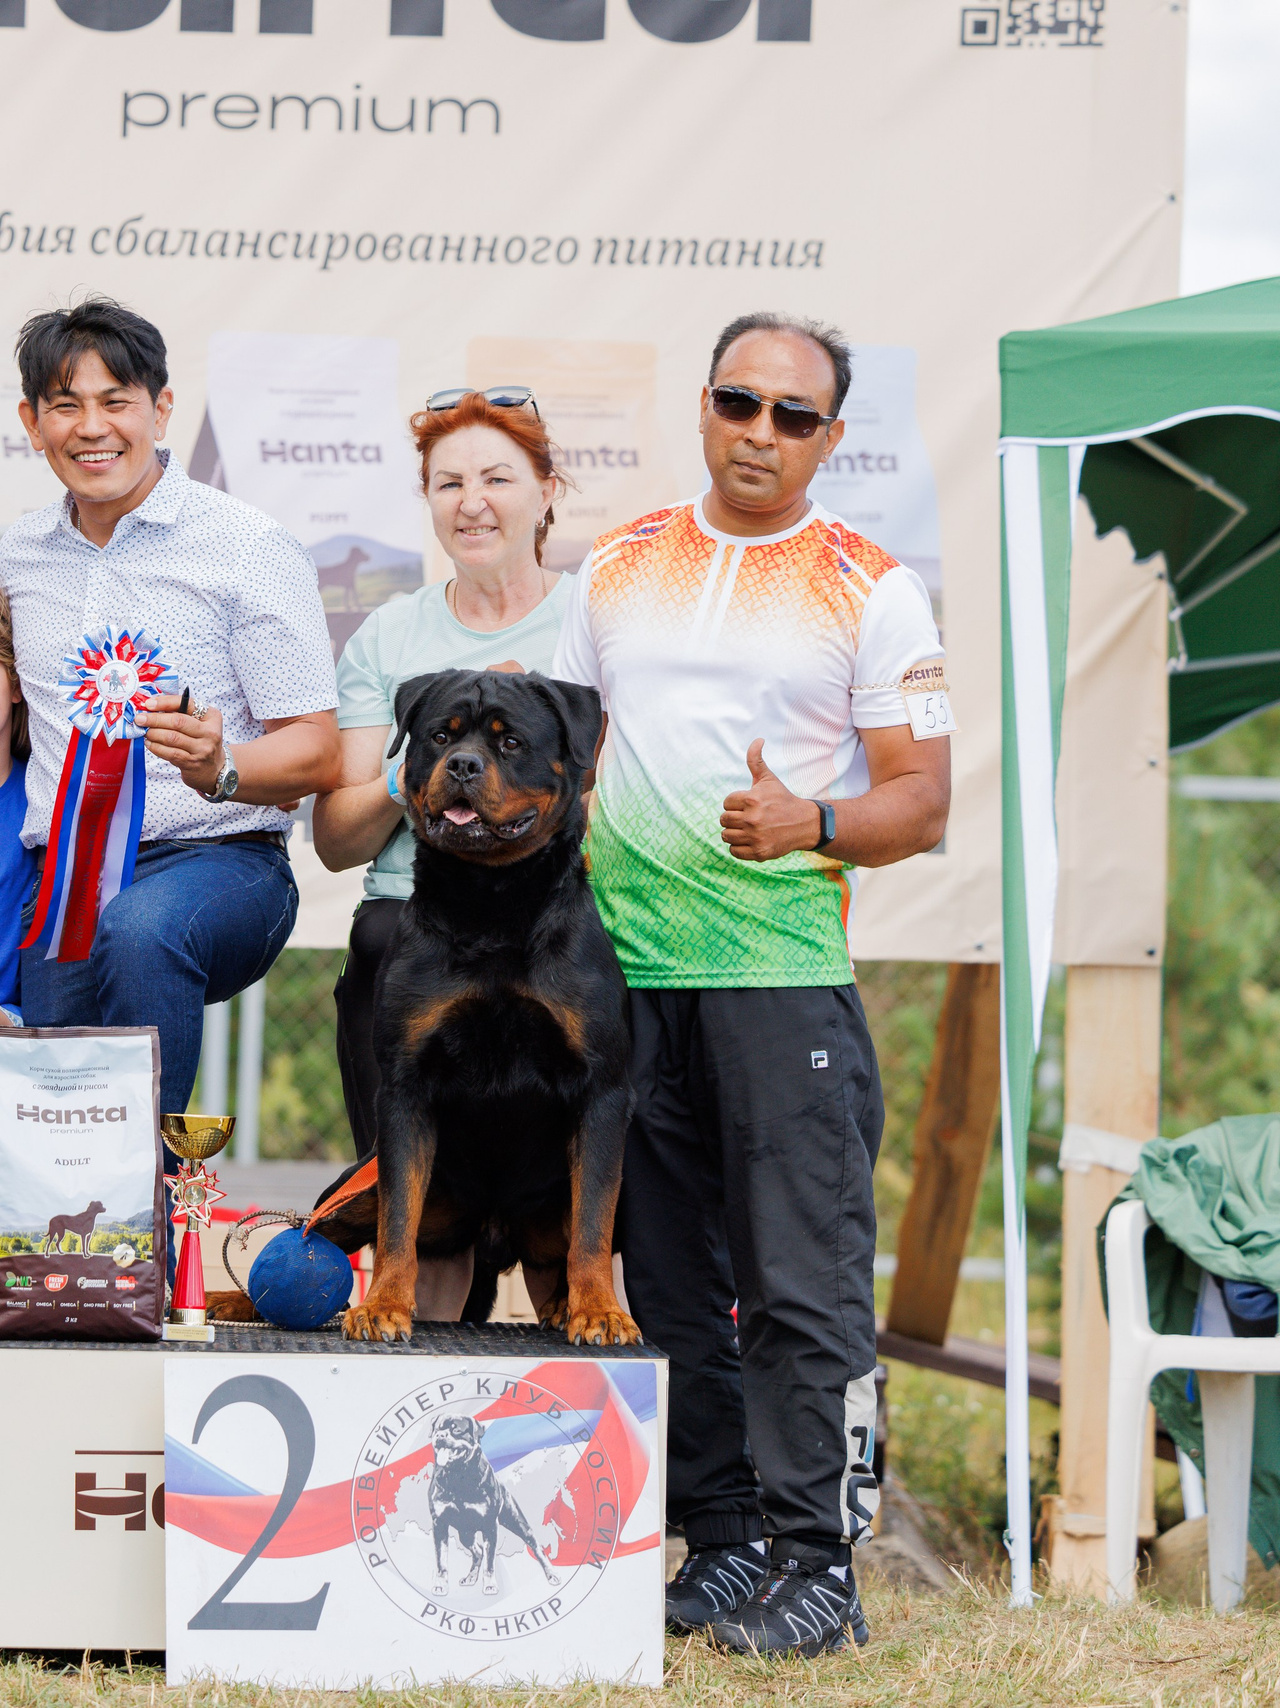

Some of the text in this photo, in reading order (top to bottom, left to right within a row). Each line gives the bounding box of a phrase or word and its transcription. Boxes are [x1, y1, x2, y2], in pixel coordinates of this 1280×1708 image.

[122, 83, 500, 139] premium
[89, 214, 581, 272] сбалансированного
[593, 233, 827, 271] питания
[259, 438, 382, 464] Hanta
[551, 445, 639, 467] anta
[816, 449, 898, 472] nta
[902, 665, 944, 683] Hanta
[84, 1083, 108, 1092] рисом
[16, 1103, 127, 1125] Hanta
[54, 1157, 91, 1166] ADULT
[356, 1376, 616, 1571] РОТВЕЙЛЕР КЛУБ РОССИИ
[75, 1472, 165, 1531] H
[187, 1374, 332, 1631] 2
[419, 1597, 563, 1637] РКФ-НКПР
